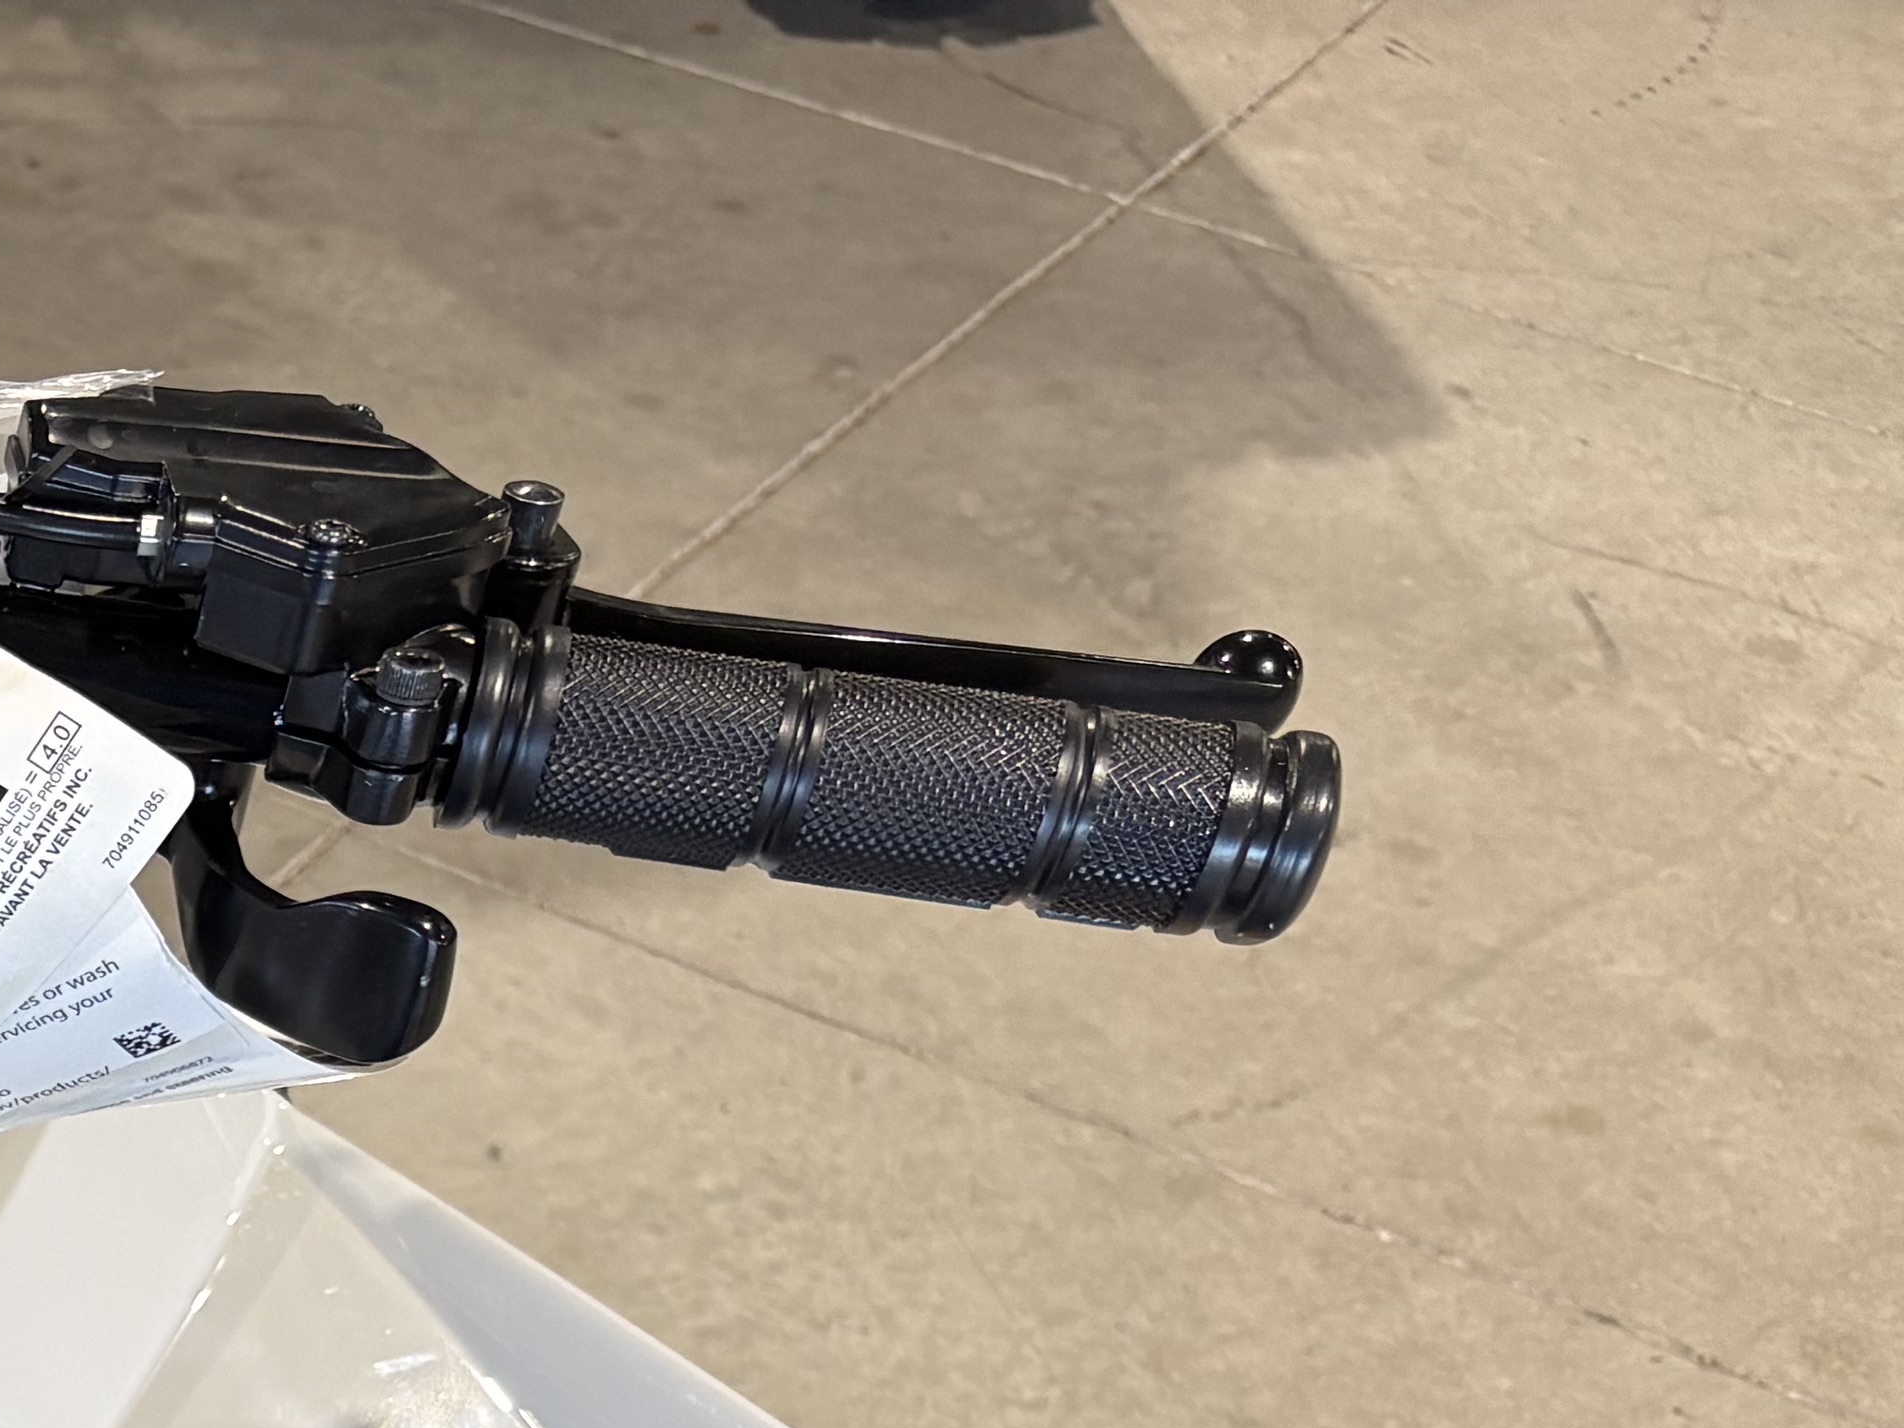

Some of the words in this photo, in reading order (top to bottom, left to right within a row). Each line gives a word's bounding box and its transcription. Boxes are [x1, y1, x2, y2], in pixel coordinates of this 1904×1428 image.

[41, 723, 71, 760] 4.0
[62, 767, 93, 799] INC.
[30, 857, 54, 880] LA
[46, 801, 94, 855] VENTE.
[41, 983, 63, 1000] or
[65, 958, 119, 990] wash
[67, 986, 113, 1017] your
